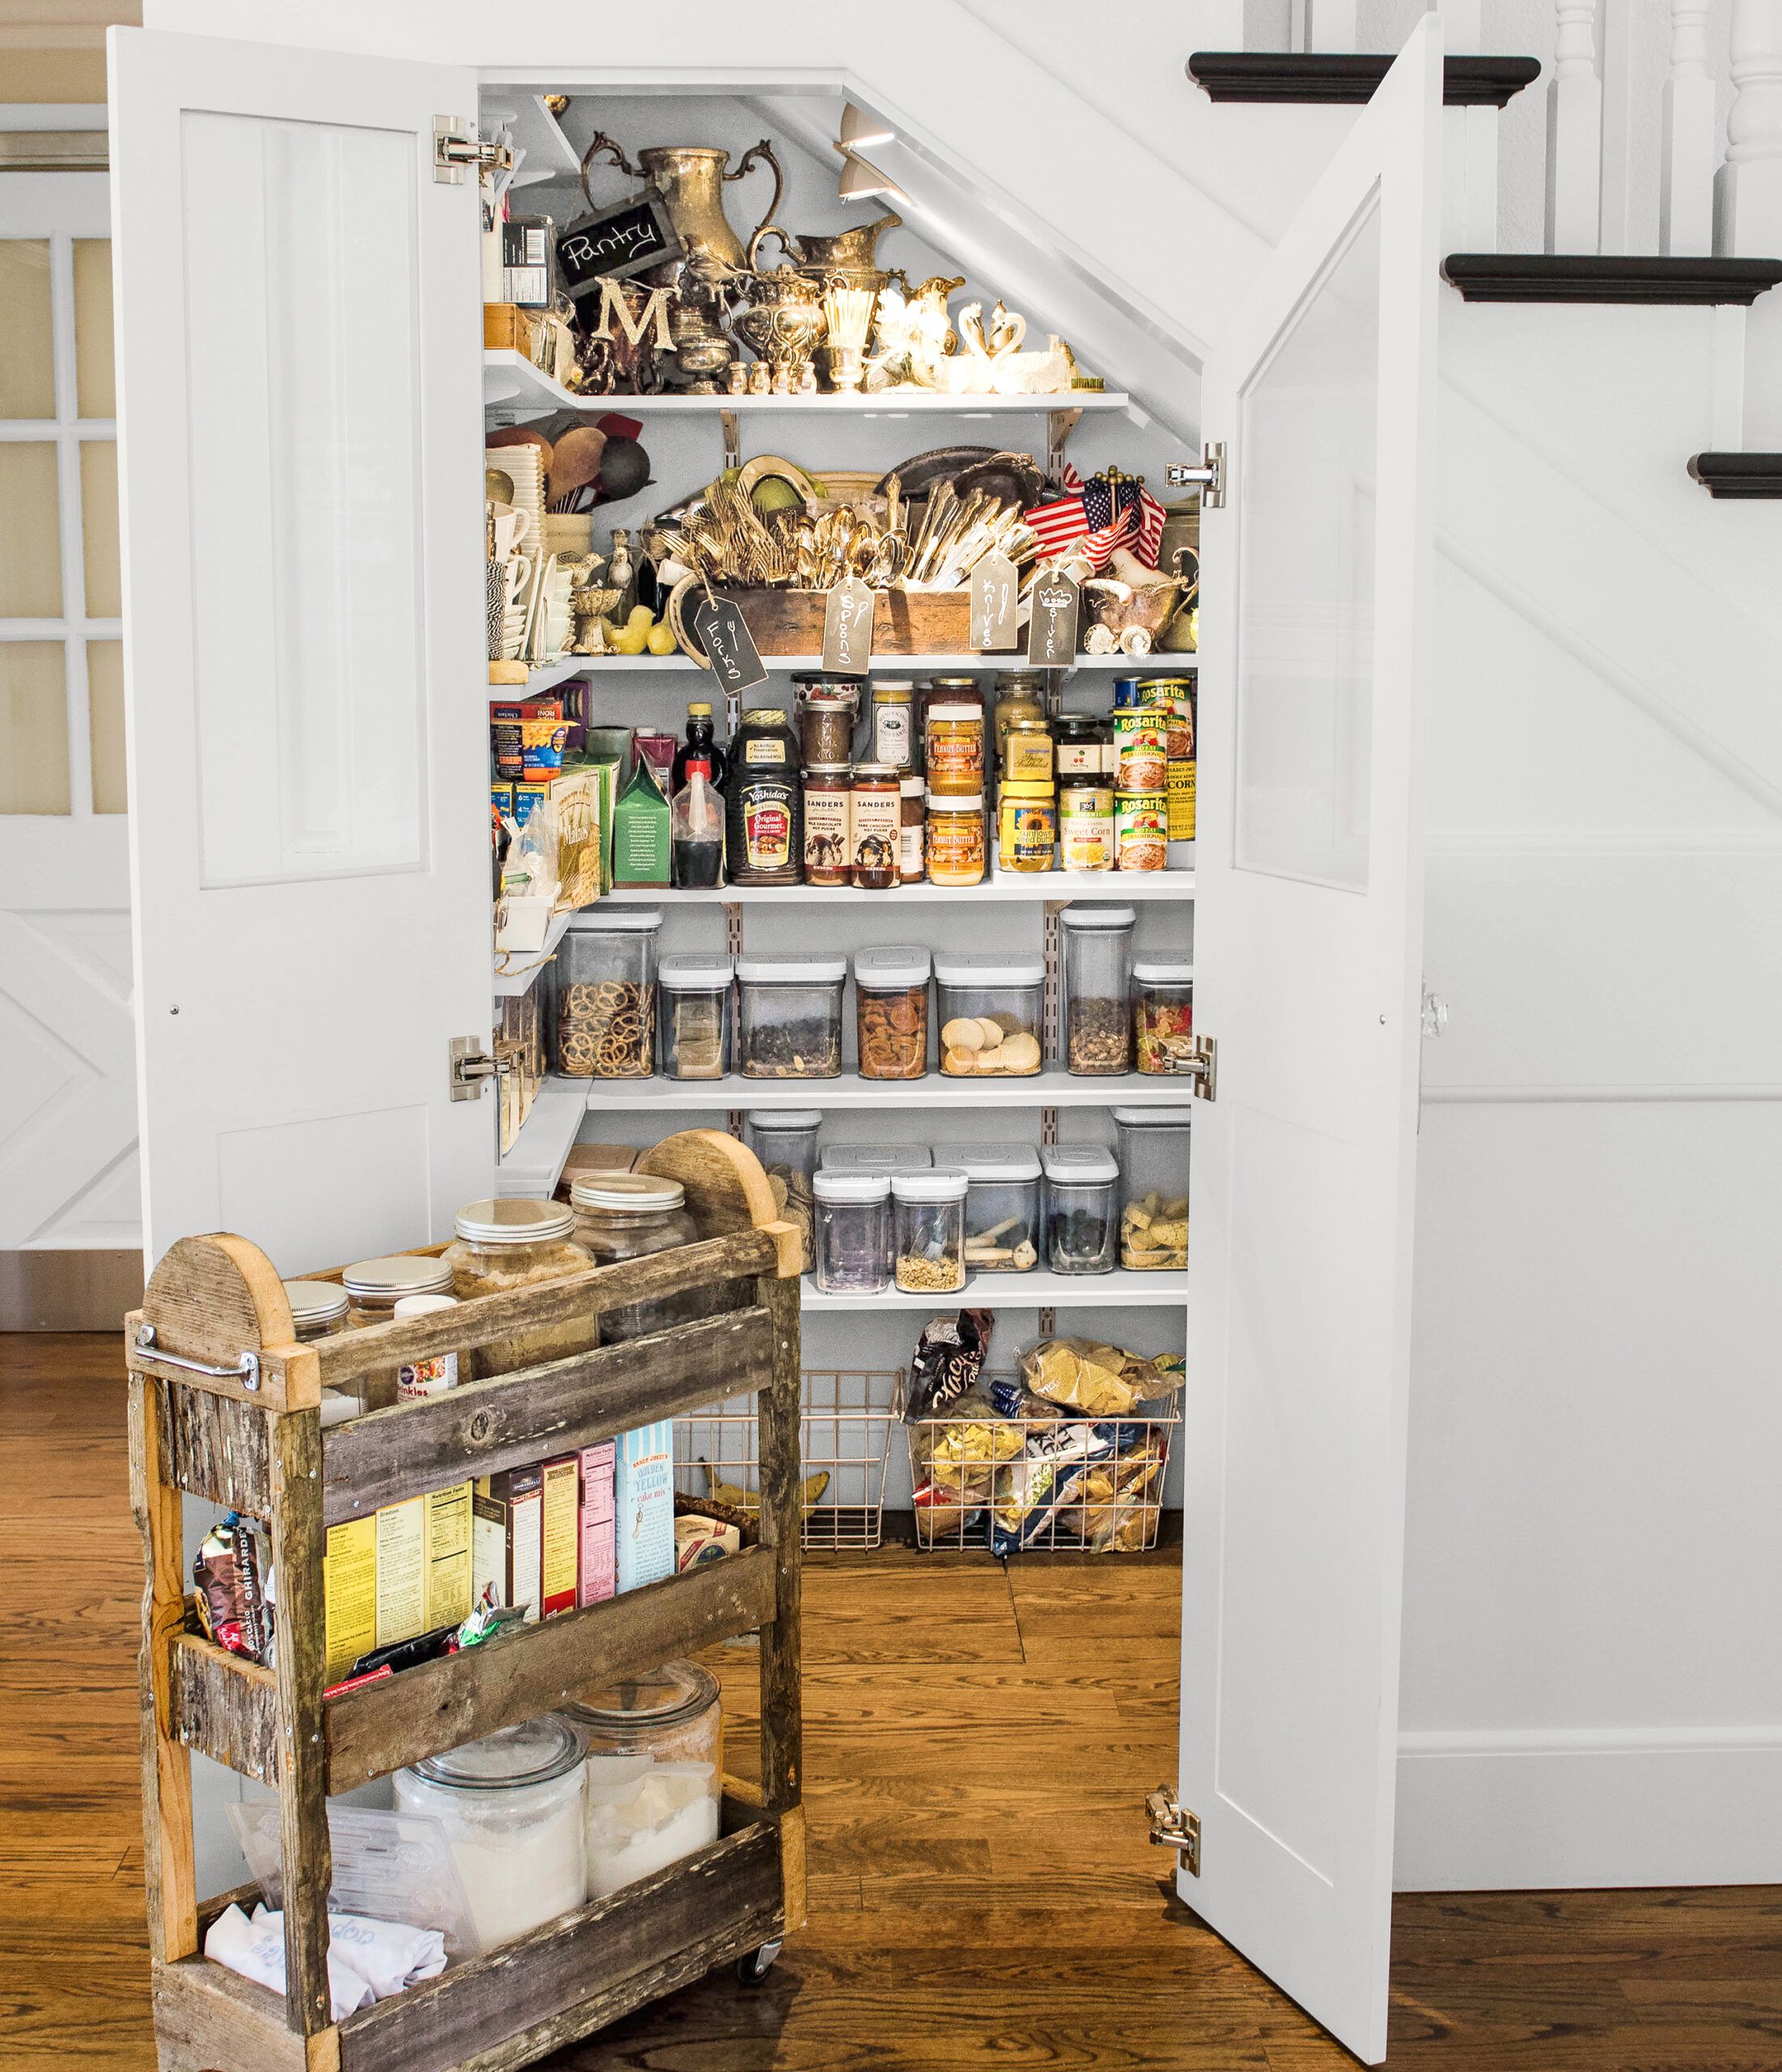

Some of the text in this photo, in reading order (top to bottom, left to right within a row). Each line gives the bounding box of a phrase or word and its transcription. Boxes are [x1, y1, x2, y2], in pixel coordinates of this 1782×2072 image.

[562, 223, 656, 270] Pantry
[591, 276, 677, 351] M
[1142, 685, 1186, 703] Rosarita
[1121, 715, 1166, 732] Rosarita
[879, 729, 907, 737] MUSTARD
[934, 743, 976, 754] PEANUT BUTTER
[1167, 779, 1195, 789] CORN
[749, 789, 789, 802] Yoshida's
[1121, 797, 1166, 814] Rosarita
[754, 814, 782, 823] Original
[1064, 827, 1110, 835] Sweet Corn
[932, 835, 974, 844] PEANUT BUTTER
[398, 1386, 428, 1397] rinkles
[638, 1463, 664, 1478] GOLDEN
[634, 1473, 668, 1492] YELLOW
[432, 1491, 452, 1499] Nutrition
[238, 1530, 253, 1601] GHIRARDE
